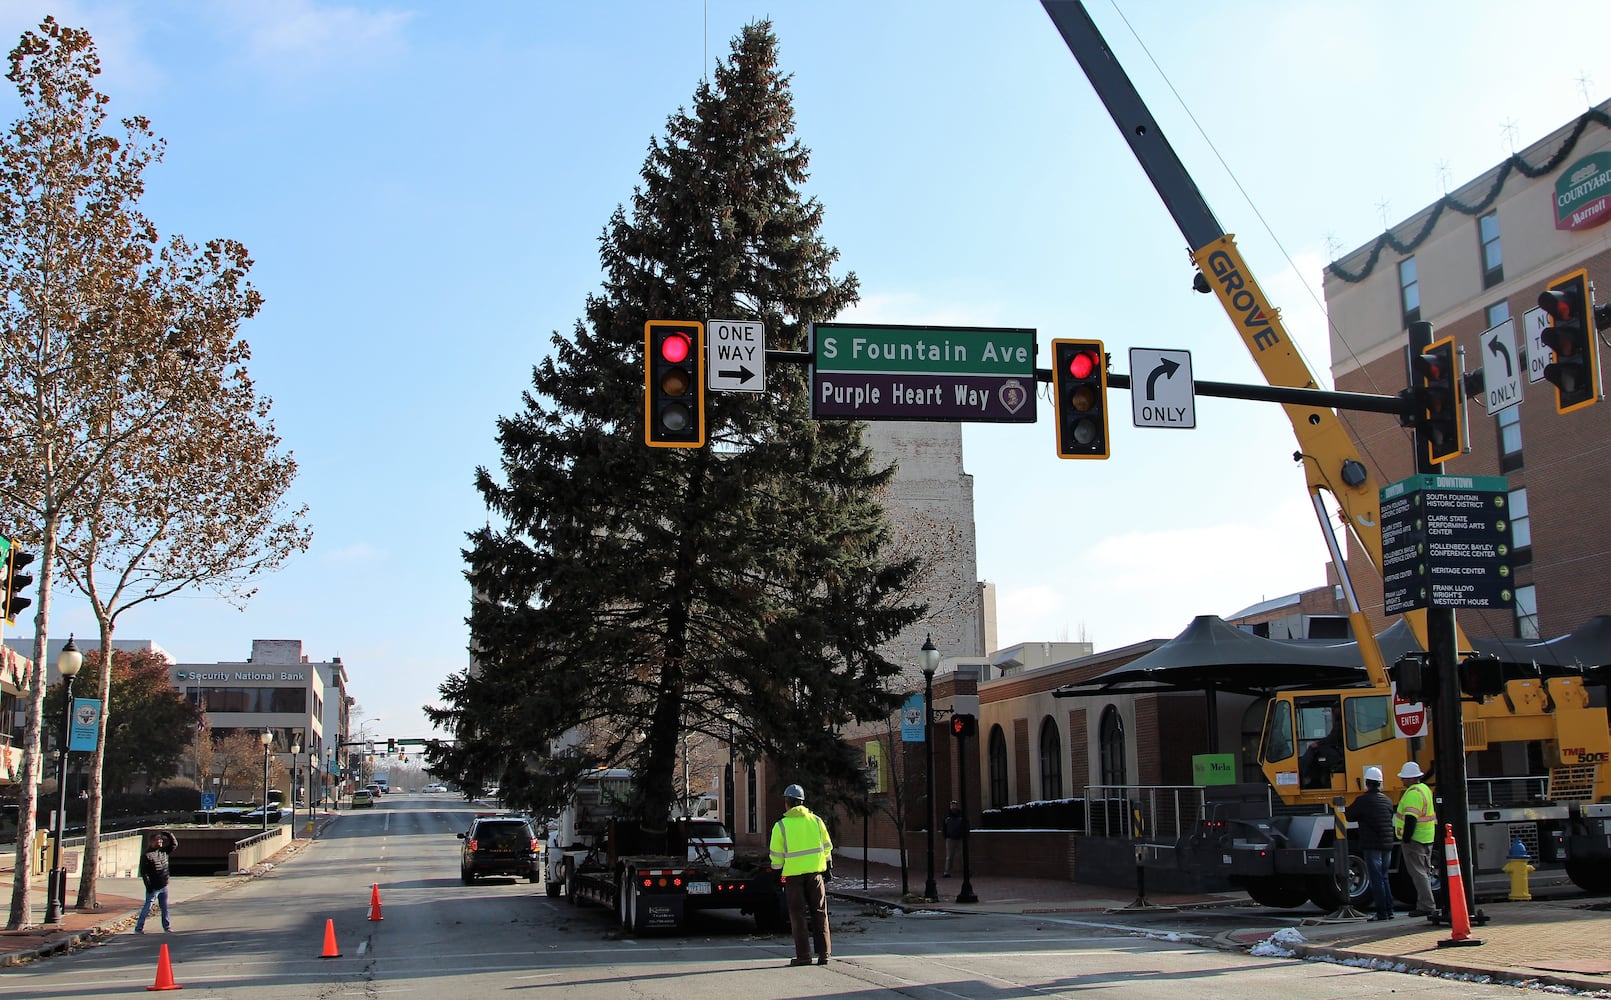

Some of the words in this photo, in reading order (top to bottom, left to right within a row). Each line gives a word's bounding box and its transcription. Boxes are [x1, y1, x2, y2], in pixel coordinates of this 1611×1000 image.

[1571, 199, 1606, 227] Marriott
[1208, 250, 1280, 352] GROVE
[718, 326, 755, 341] ONE
[718, 345, 756, 361] WAY
[823, 337, 838, 359] S
[852, 338, 967, 362] Fountain
[981, 341, 1028, 363] Ave
[822, 381, 881, 409] Purple
[892, 383, 943, 405] Heart
[954, 384, 990, 411] Way
[1490, 381, 1517, 407] ONLY
[1142, 406, 1186, 422] ONLY
[1436, 477, 1473, 488] DOWNTOWN
[1448, 494, 1479, 502] FOUNTAIN
[1469, 522, 1485, 530] ARTS
[1461, 567, 1486, 575] CENTER
[1432, 584, 1454, 592] FRANK
[1433, 591, 1463, 599] WRIGHT'S
[189, 671, 230, 682] Security
[235, 671, 275, 680] National
[280, 671, 304, 680] Bank
[1401, 715, 1420, 727] ENTER
[1210, 762, 1231, 772] Mela
